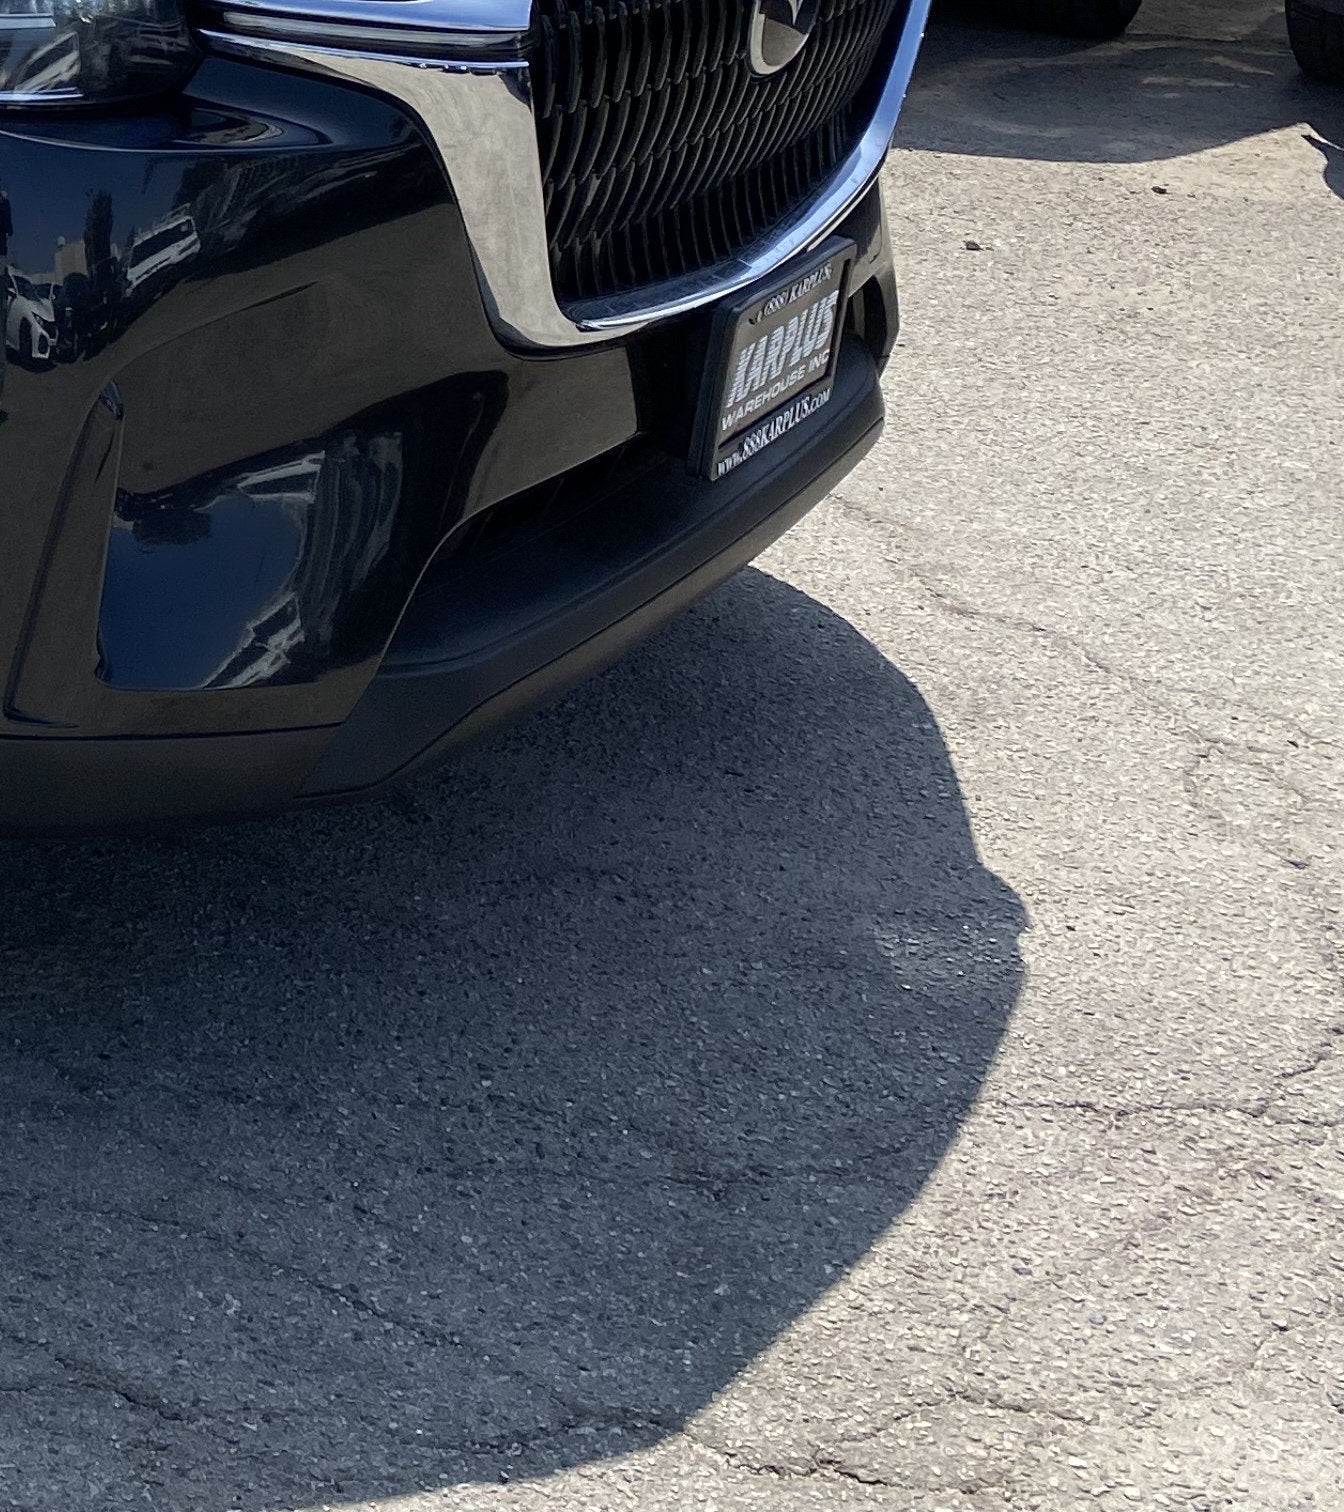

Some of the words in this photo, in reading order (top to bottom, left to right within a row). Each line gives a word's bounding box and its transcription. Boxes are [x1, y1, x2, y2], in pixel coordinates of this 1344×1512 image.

[788, 262, 833, 304] KARPLUS
[722, 364, 806, 431] WAREHOUSE
[809, 348, 830, 375] INC
[725, 289, 840, 408] KARPLUS
